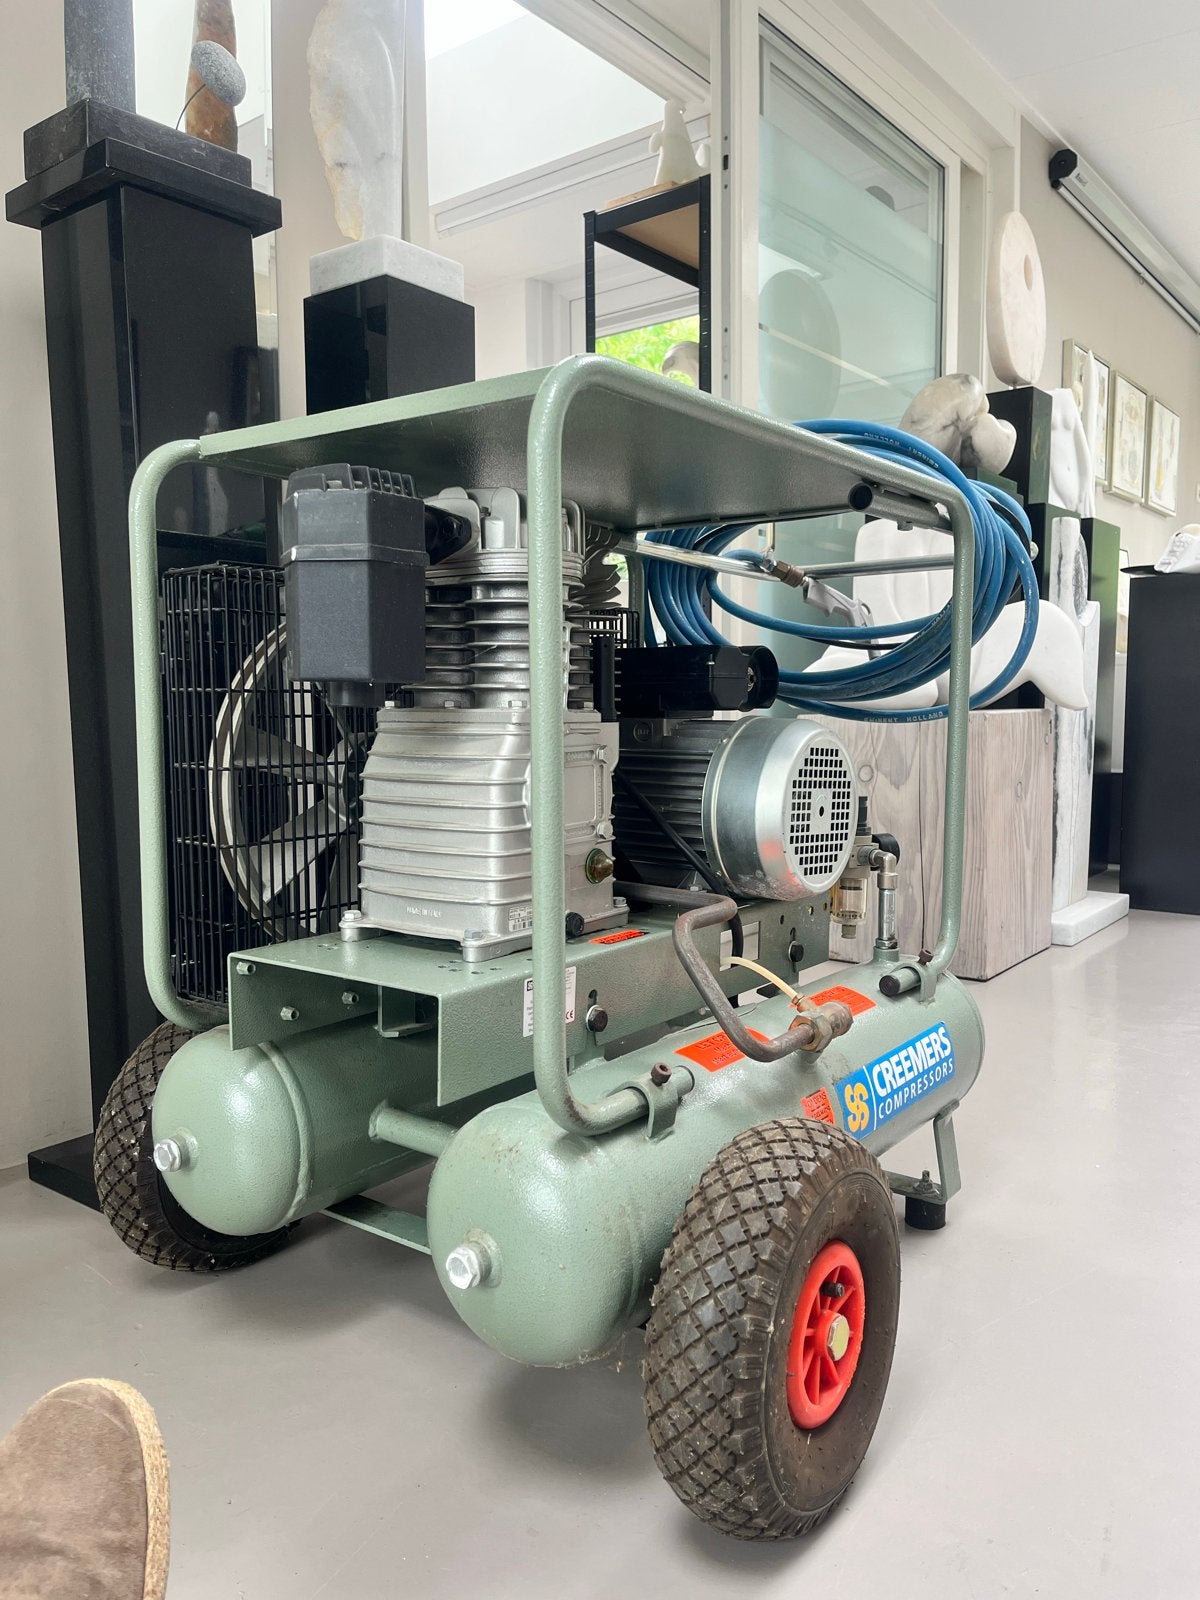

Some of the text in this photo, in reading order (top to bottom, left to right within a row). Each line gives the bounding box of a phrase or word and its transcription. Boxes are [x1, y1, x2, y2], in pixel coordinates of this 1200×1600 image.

[906, 711, 944, 722] HOLLAND
[872, 1026, 952, 1098] CREEMERS
[878, 1058, 954, 1119] COMPRESSORS
